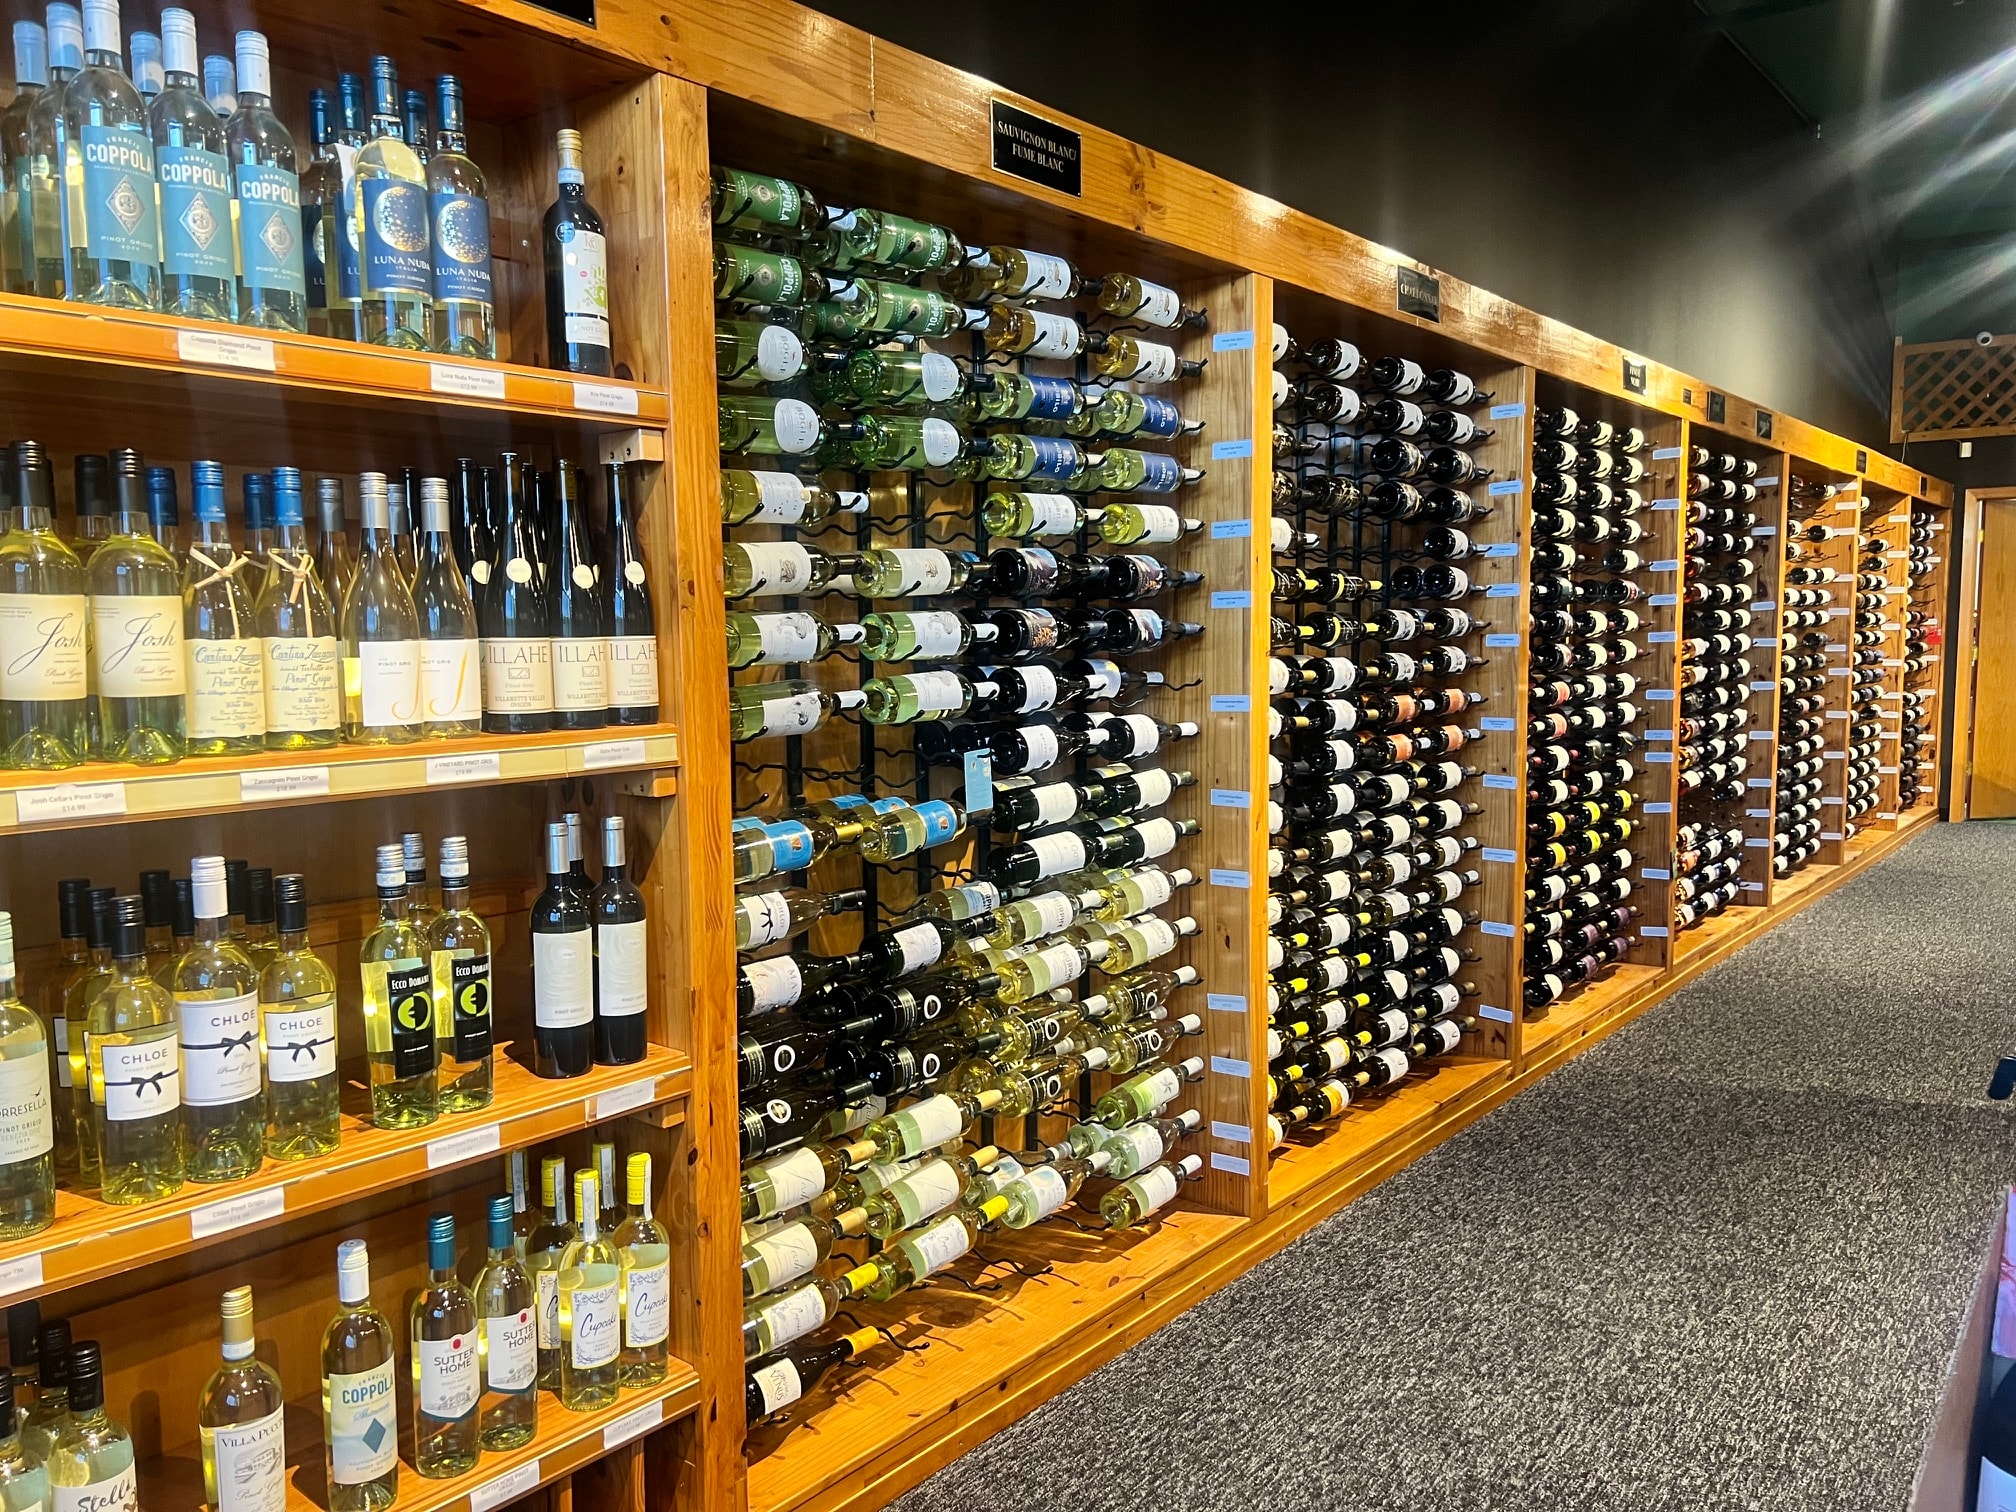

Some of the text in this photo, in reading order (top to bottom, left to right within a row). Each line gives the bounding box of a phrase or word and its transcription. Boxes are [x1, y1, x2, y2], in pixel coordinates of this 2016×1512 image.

[997, 120, 1048, 150] SAUVIGNON
[86, 143, 152, 173] COPPOLA
[1012, 142, 1064, 173] FUME BLANC
[161, 163, 227, 191] COPPOLA
[775, 178, 793, 221] COPPOLA
[374, 255, 431, 271] LUNA NUDA
[436, 267, 491, 282] LUNA NUDA
[776, 258, 795, 302] COPPOLA
[1051, 381, 1062, 413] NOBILO
[1053, 442, 1063, 474] NOBILO
[1154, 462, 1167, 490] NOBILO
[7, 612, 84, 676] Josh
[102, 612, 177, 673] Josh
[488, 644, 549, 664] ILLAHE
[30, 797, 48, 805] Josh
[48, 795, 73, 804] Cellars
[210, 1009, 256, 1028] CHLOE
[279, 1017, 323, 1031] CHLOE
[121, 1048, 168, 1065] CHLOE
[0, 1097, 47, 1118] RRESELLA
[508, 1331, 535, 1349] HOME
[433, 1346, 475, 1367] SUTTER
[440, 1357, 472, 1375] HOME
[342, 1372, 394, 1404] COPPOLA
[221, 1434, 257, 1448] VILLA
